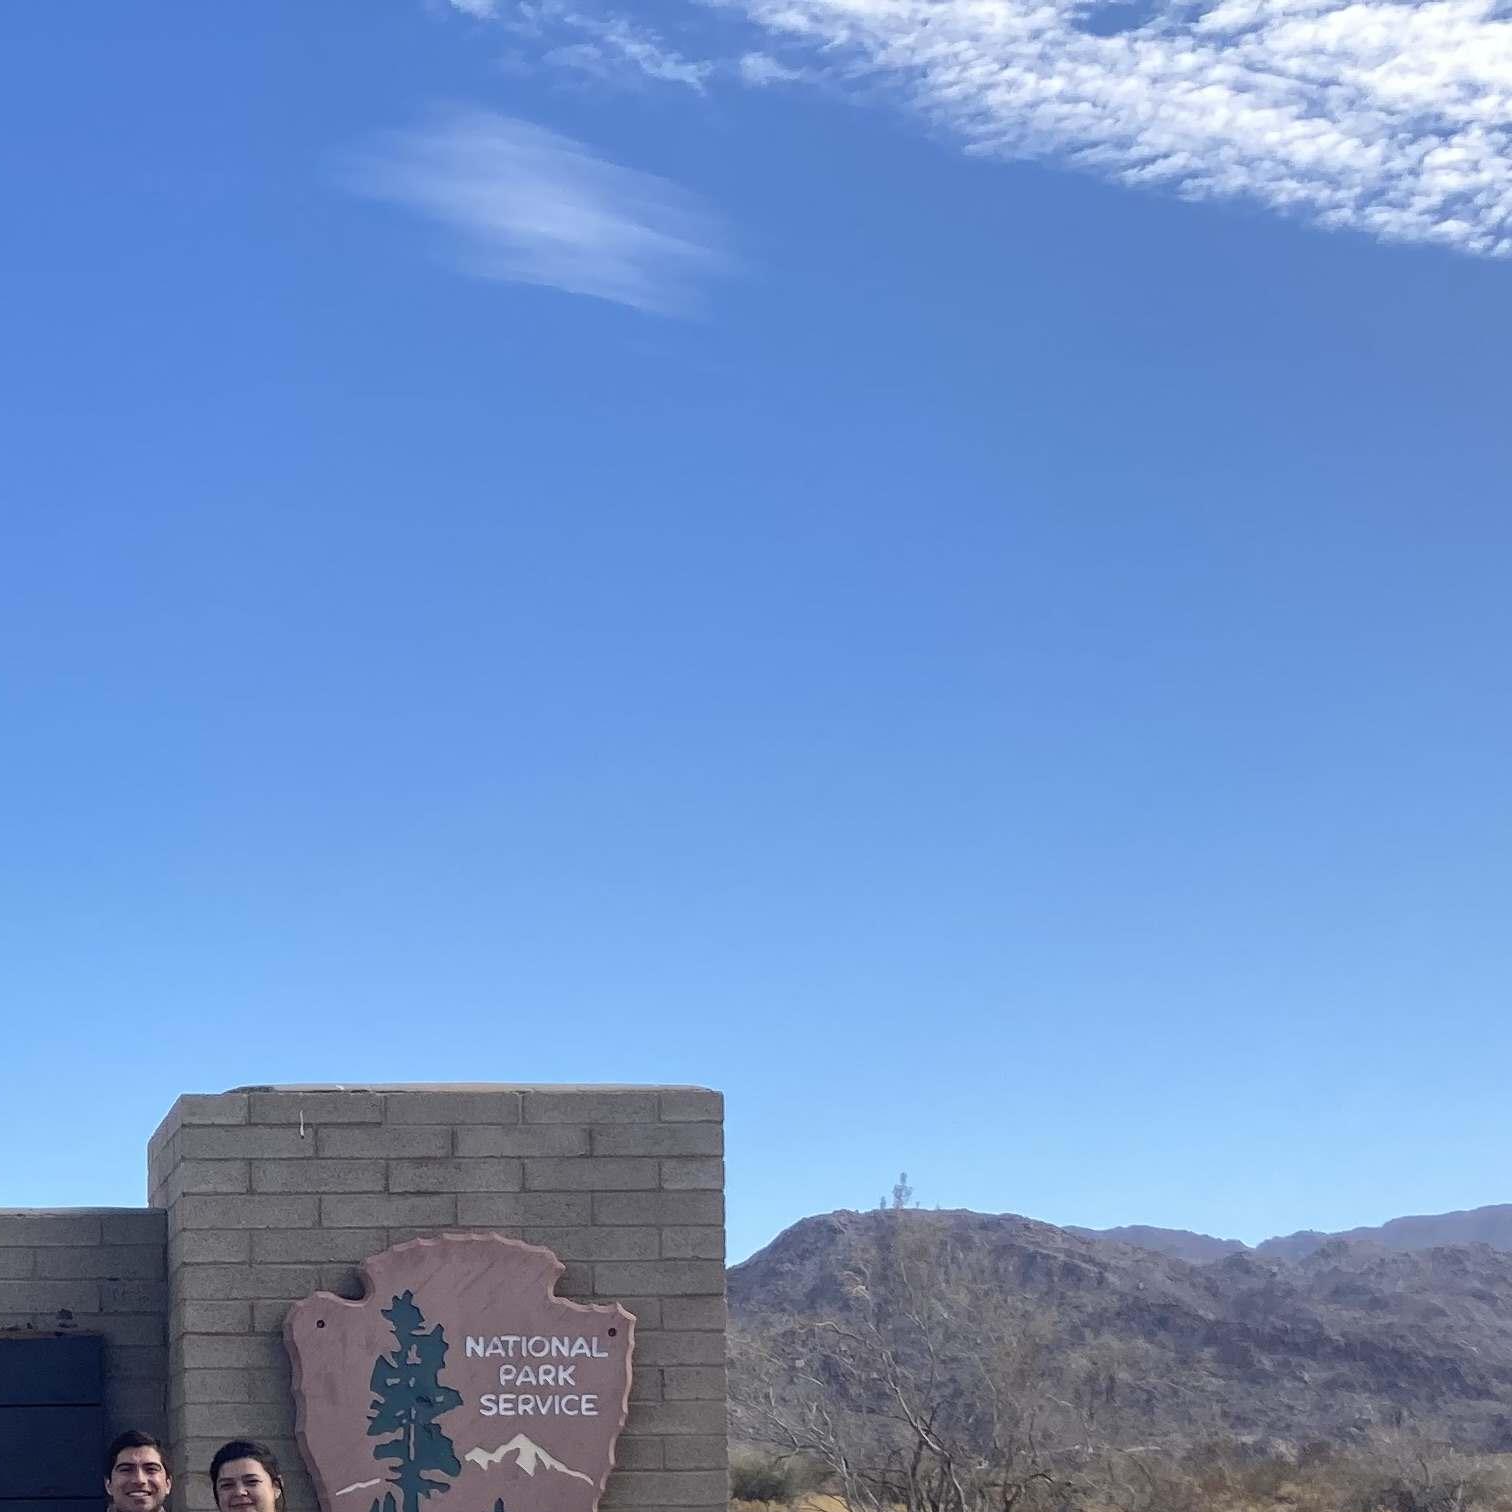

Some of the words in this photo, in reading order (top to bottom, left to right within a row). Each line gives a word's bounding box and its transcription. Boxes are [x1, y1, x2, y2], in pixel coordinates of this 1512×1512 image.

[464, 1335, 609, 1358] NATIONAL
[499, 1364, 577, 1386] PARK
[479, 1393, 600, 1416] SERVICE
